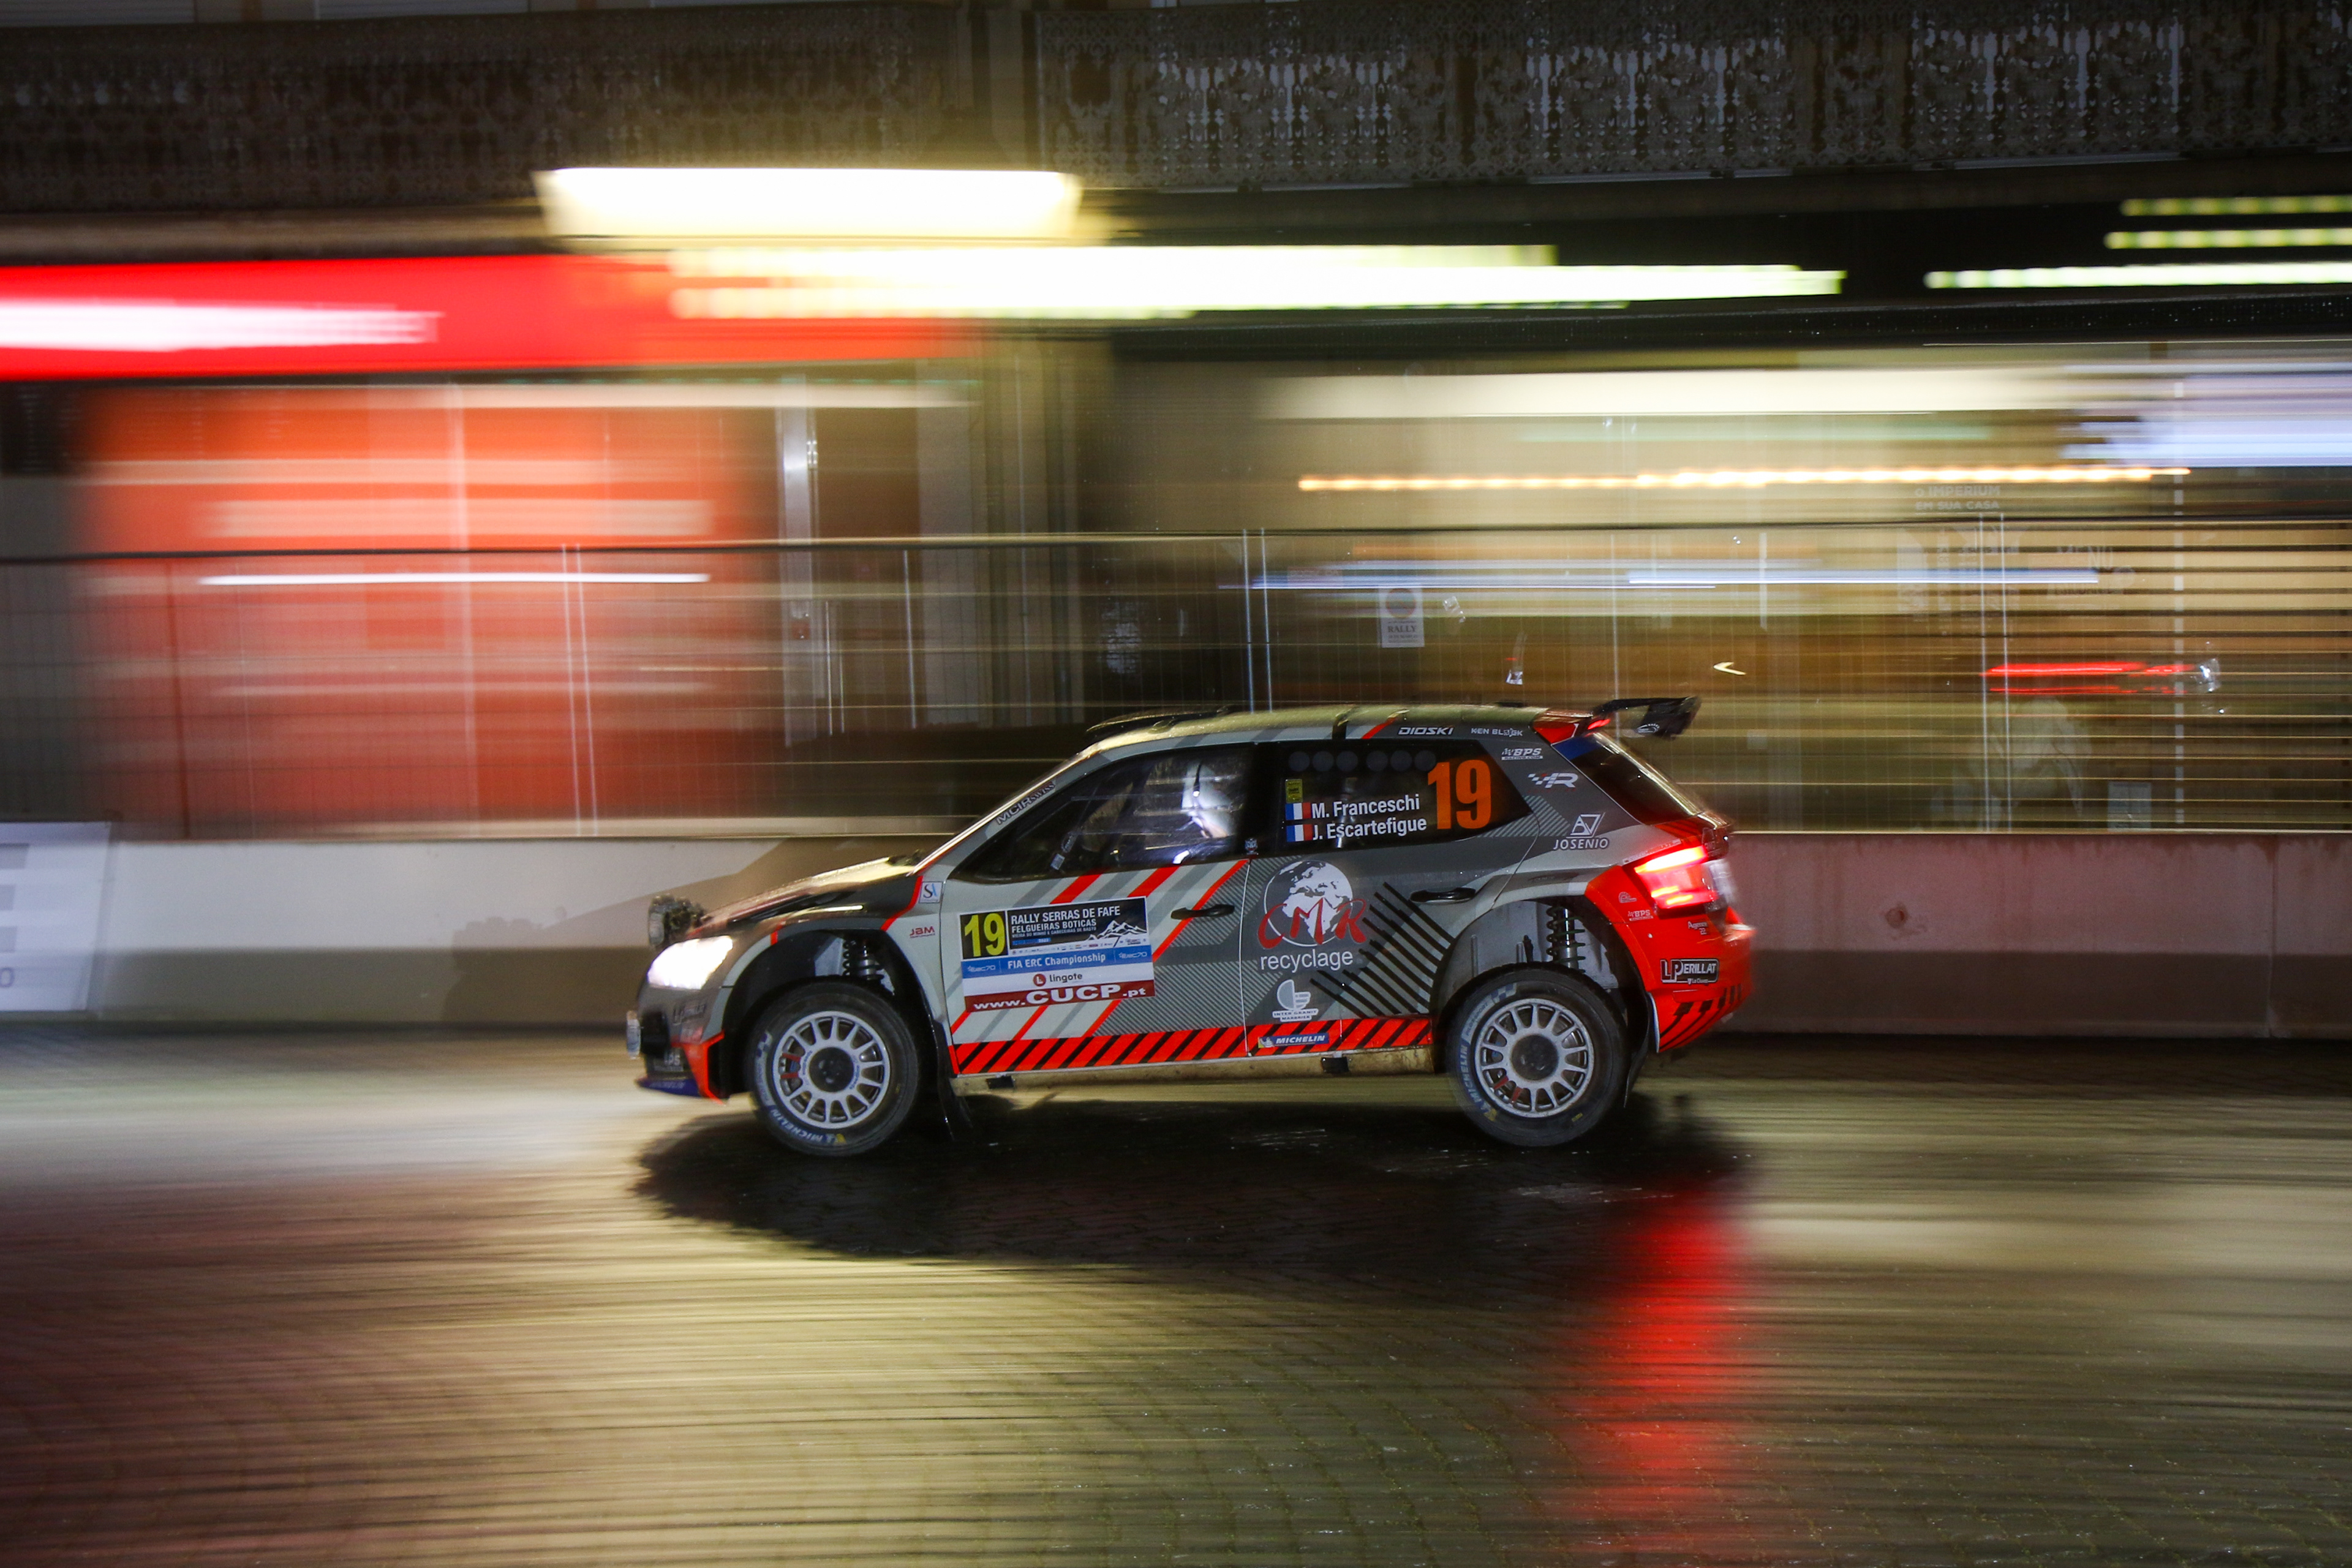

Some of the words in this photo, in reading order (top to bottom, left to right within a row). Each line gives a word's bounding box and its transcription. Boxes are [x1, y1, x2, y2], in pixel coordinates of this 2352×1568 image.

[1929, 485, 2000, 497] IMPERIUM
[1938, 500, 1960, 510] SUA
[1966, 500, 2000, 510] CASA
[1398, 726, 1454, 736] DIOSKI
[1513, 748, 1542, 756] BPS
[1427, 759, 1492, 830] 19
[1311, 802, 1329, 819] M.
[1333, 794, 1420, 817] Franceschi
[1313, 824, 1323, 840] J.
[1327, 816, 1427, 839] Escartefigue
[1553, 838, 1609, 850] JOSENIO
[1011, 913, 1040, 925] RALLY
[1042, 909, 1080, 922] SERRAS
[1082, 908, 1095, 919] DE
[1098, 905, 1121, 917] FAFE
[1257, 897, 1366, 949] CMR
[963, 912, 1005, 958] 19
[1011, 921, 1060, 934] FELGUEIRAS
[1062, 918, 1097, 929] BOTICAS
[1008, 960, 1023, 970] FIA
[1025, 957, 1042, 968] ERC
[1045, 953, 1106, 967] Championship
[1260, 949, 1354, 973] recyclage
[1049, 972, 1083, 983] lingote
[973, 984, 1146, 1010] www.CUCP.pt
[1276, 1035, 1325, 1044] MICHELIN
[770, 1108, 824, 1143] MICHELIN
